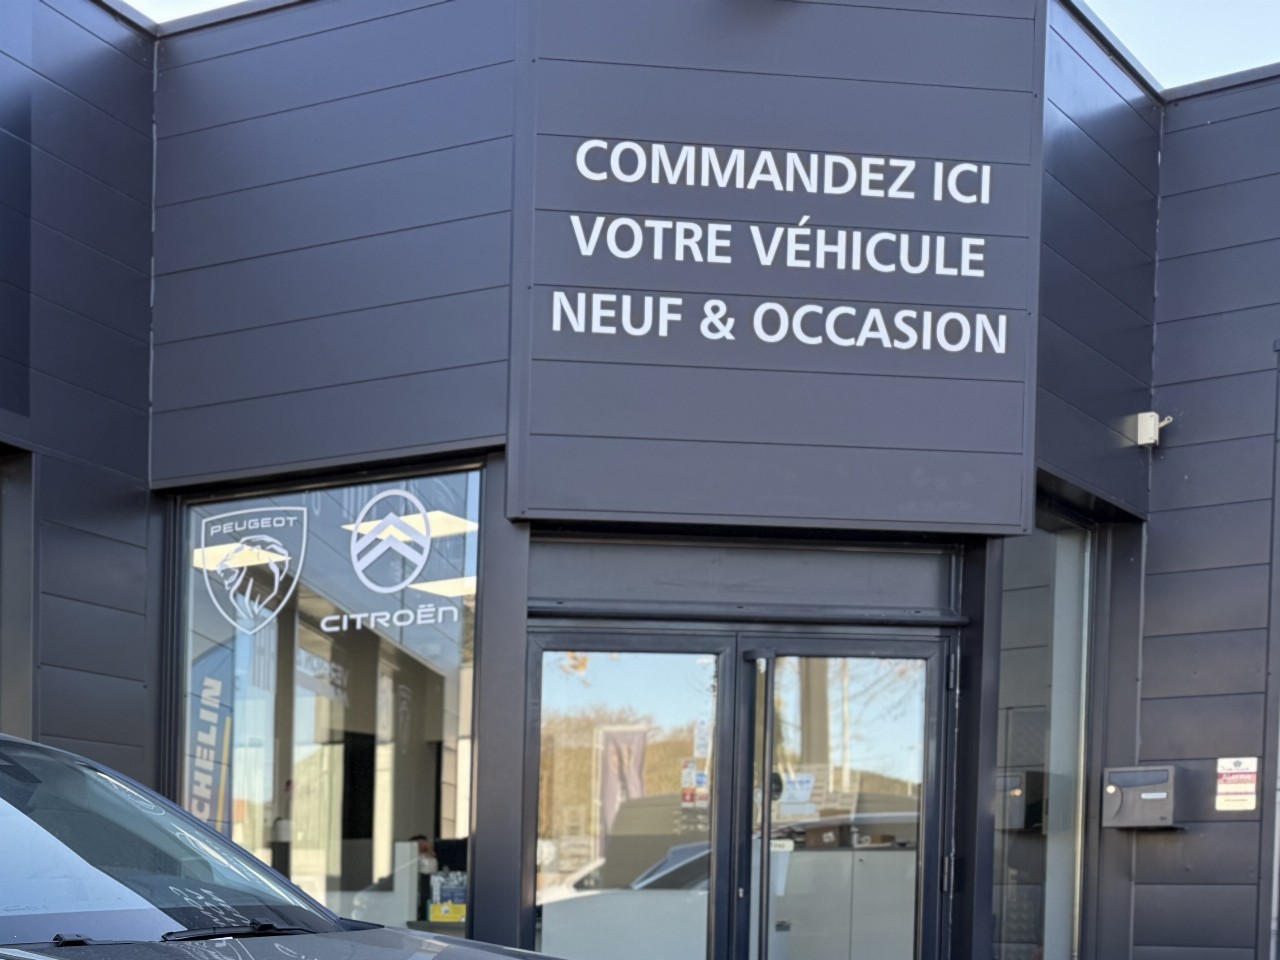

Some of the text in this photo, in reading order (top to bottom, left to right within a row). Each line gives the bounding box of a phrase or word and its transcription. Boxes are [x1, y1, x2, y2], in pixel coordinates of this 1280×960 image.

[575, 139, 991, 205] COMMANDEZ ICI
[570, 216, 985, 277] VOTRE VÉHICULE
[551, 291, 1008, 354] NEUF & OCCASION
[210, 516, 297, 535] PEUGEOT
[320, 603, 458, 633] CITROËN
[191, 676, 222, 823] CHELIN
